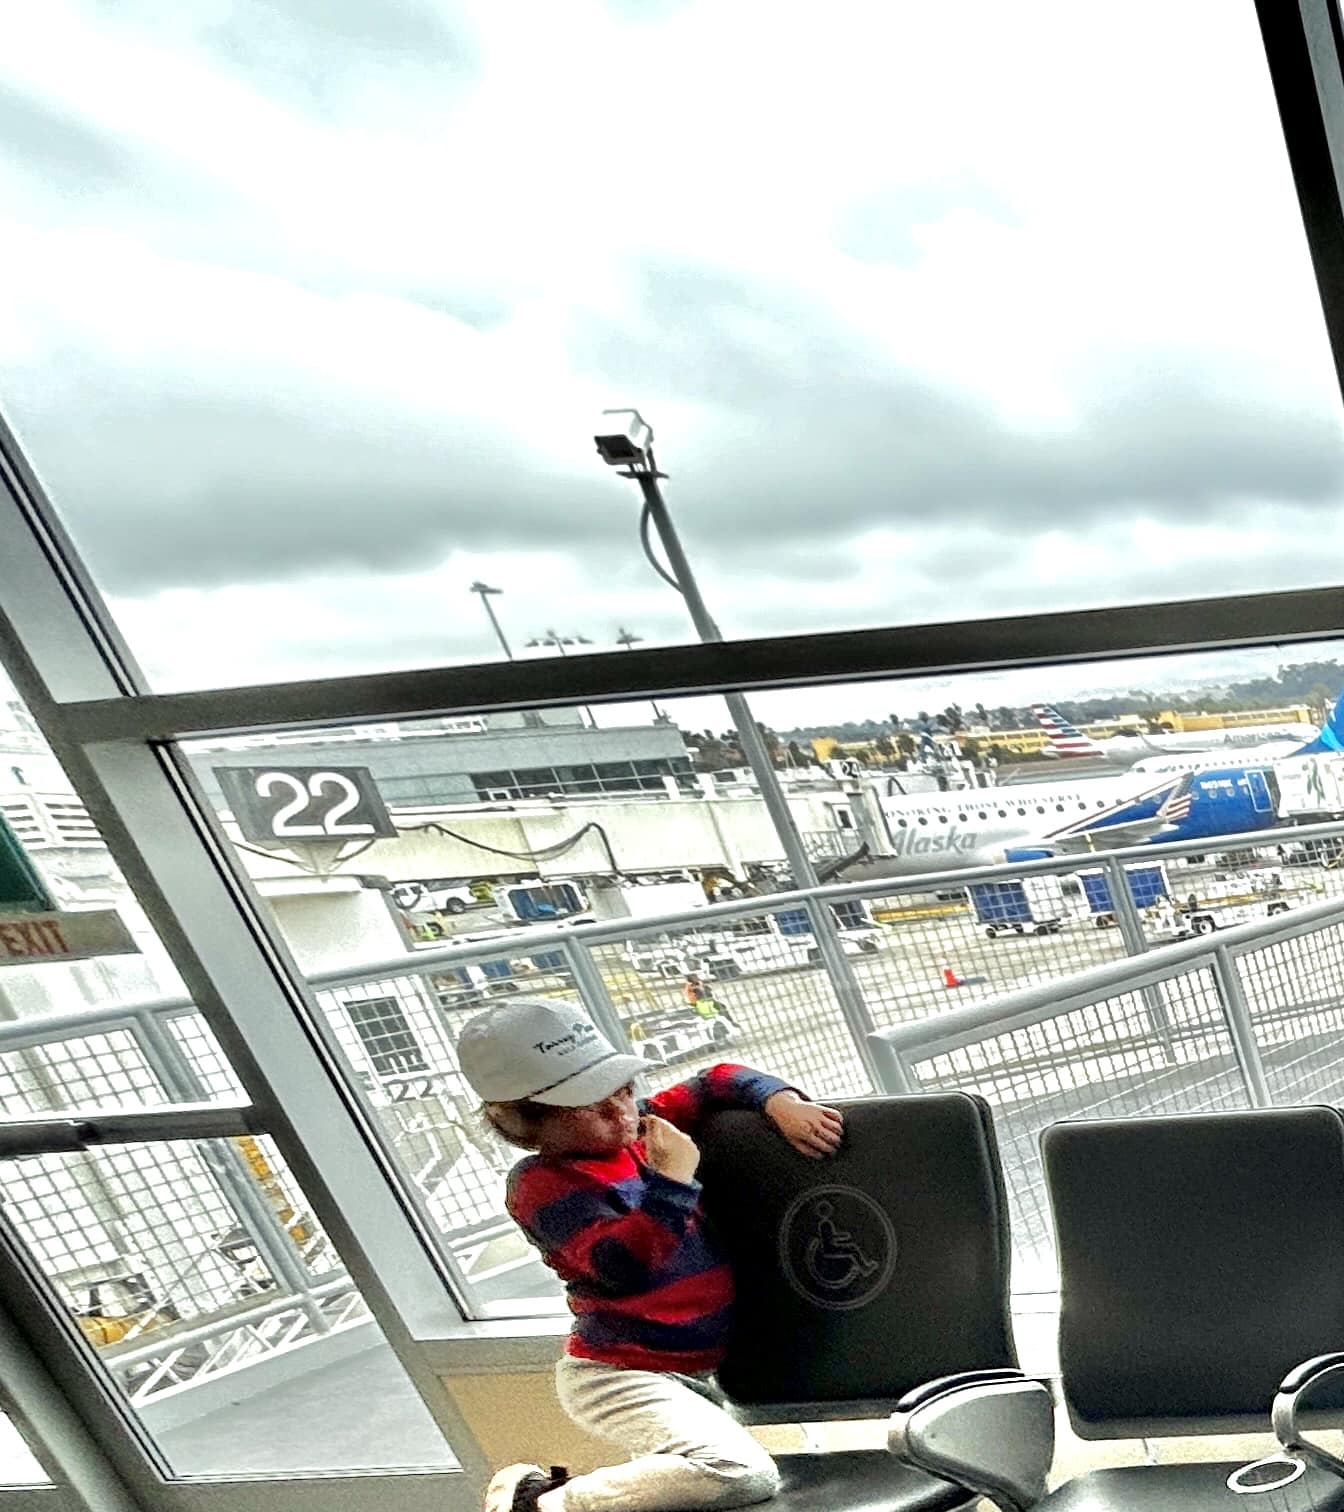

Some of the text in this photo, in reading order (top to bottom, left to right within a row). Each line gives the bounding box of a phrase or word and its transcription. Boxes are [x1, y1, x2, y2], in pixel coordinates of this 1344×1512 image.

[256, 772, 376, 836] 22
[884, 806, 951, 818] ONORING
[892, 825, 978, 856] Alaska
[0, 920, 69, 955] EXIT
